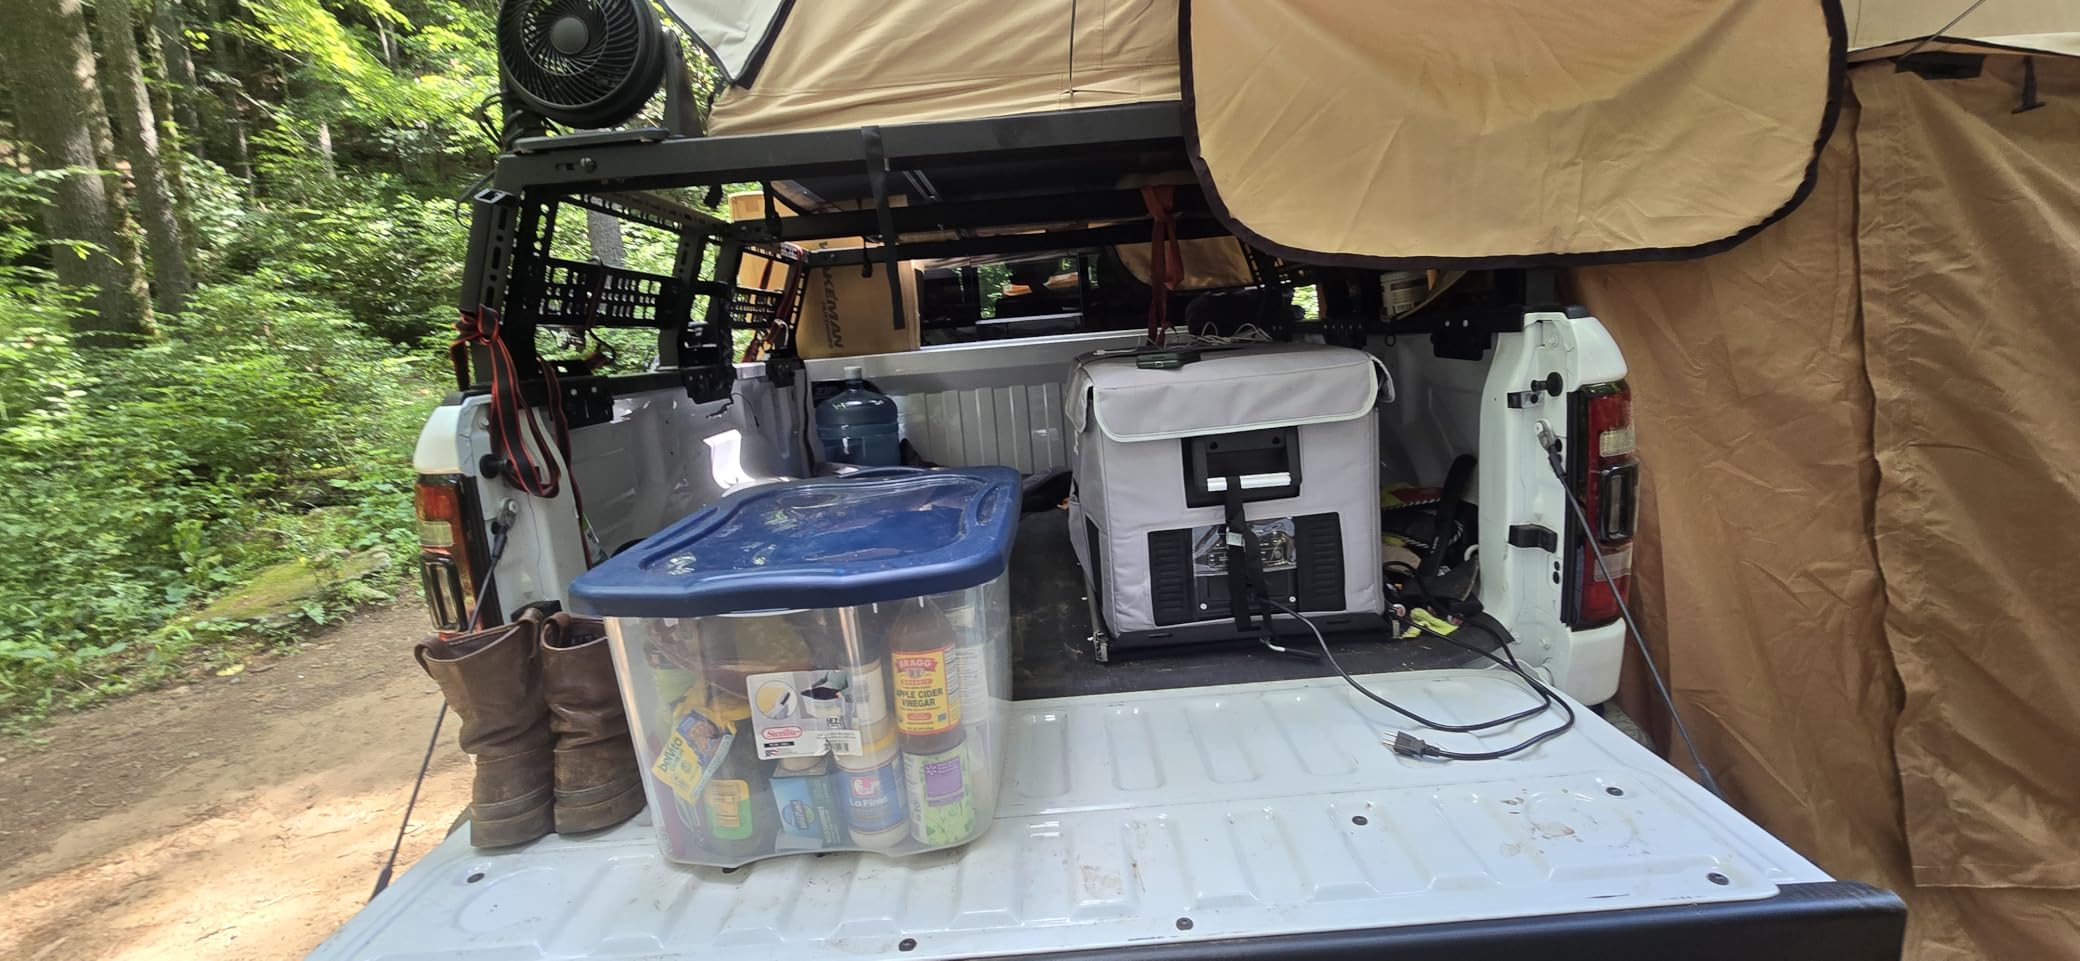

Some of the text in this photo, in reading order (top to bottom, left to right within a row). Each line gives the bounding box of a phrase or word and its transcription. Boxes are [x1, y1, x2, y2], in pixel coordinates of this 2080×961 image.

[898, 658, 931, 669] BRAGG
[896, 688, 944, 699] APPLE CIDER
[901, 698, 936, 707] VINEGAR
[658, 736, 684, 772] belVita
